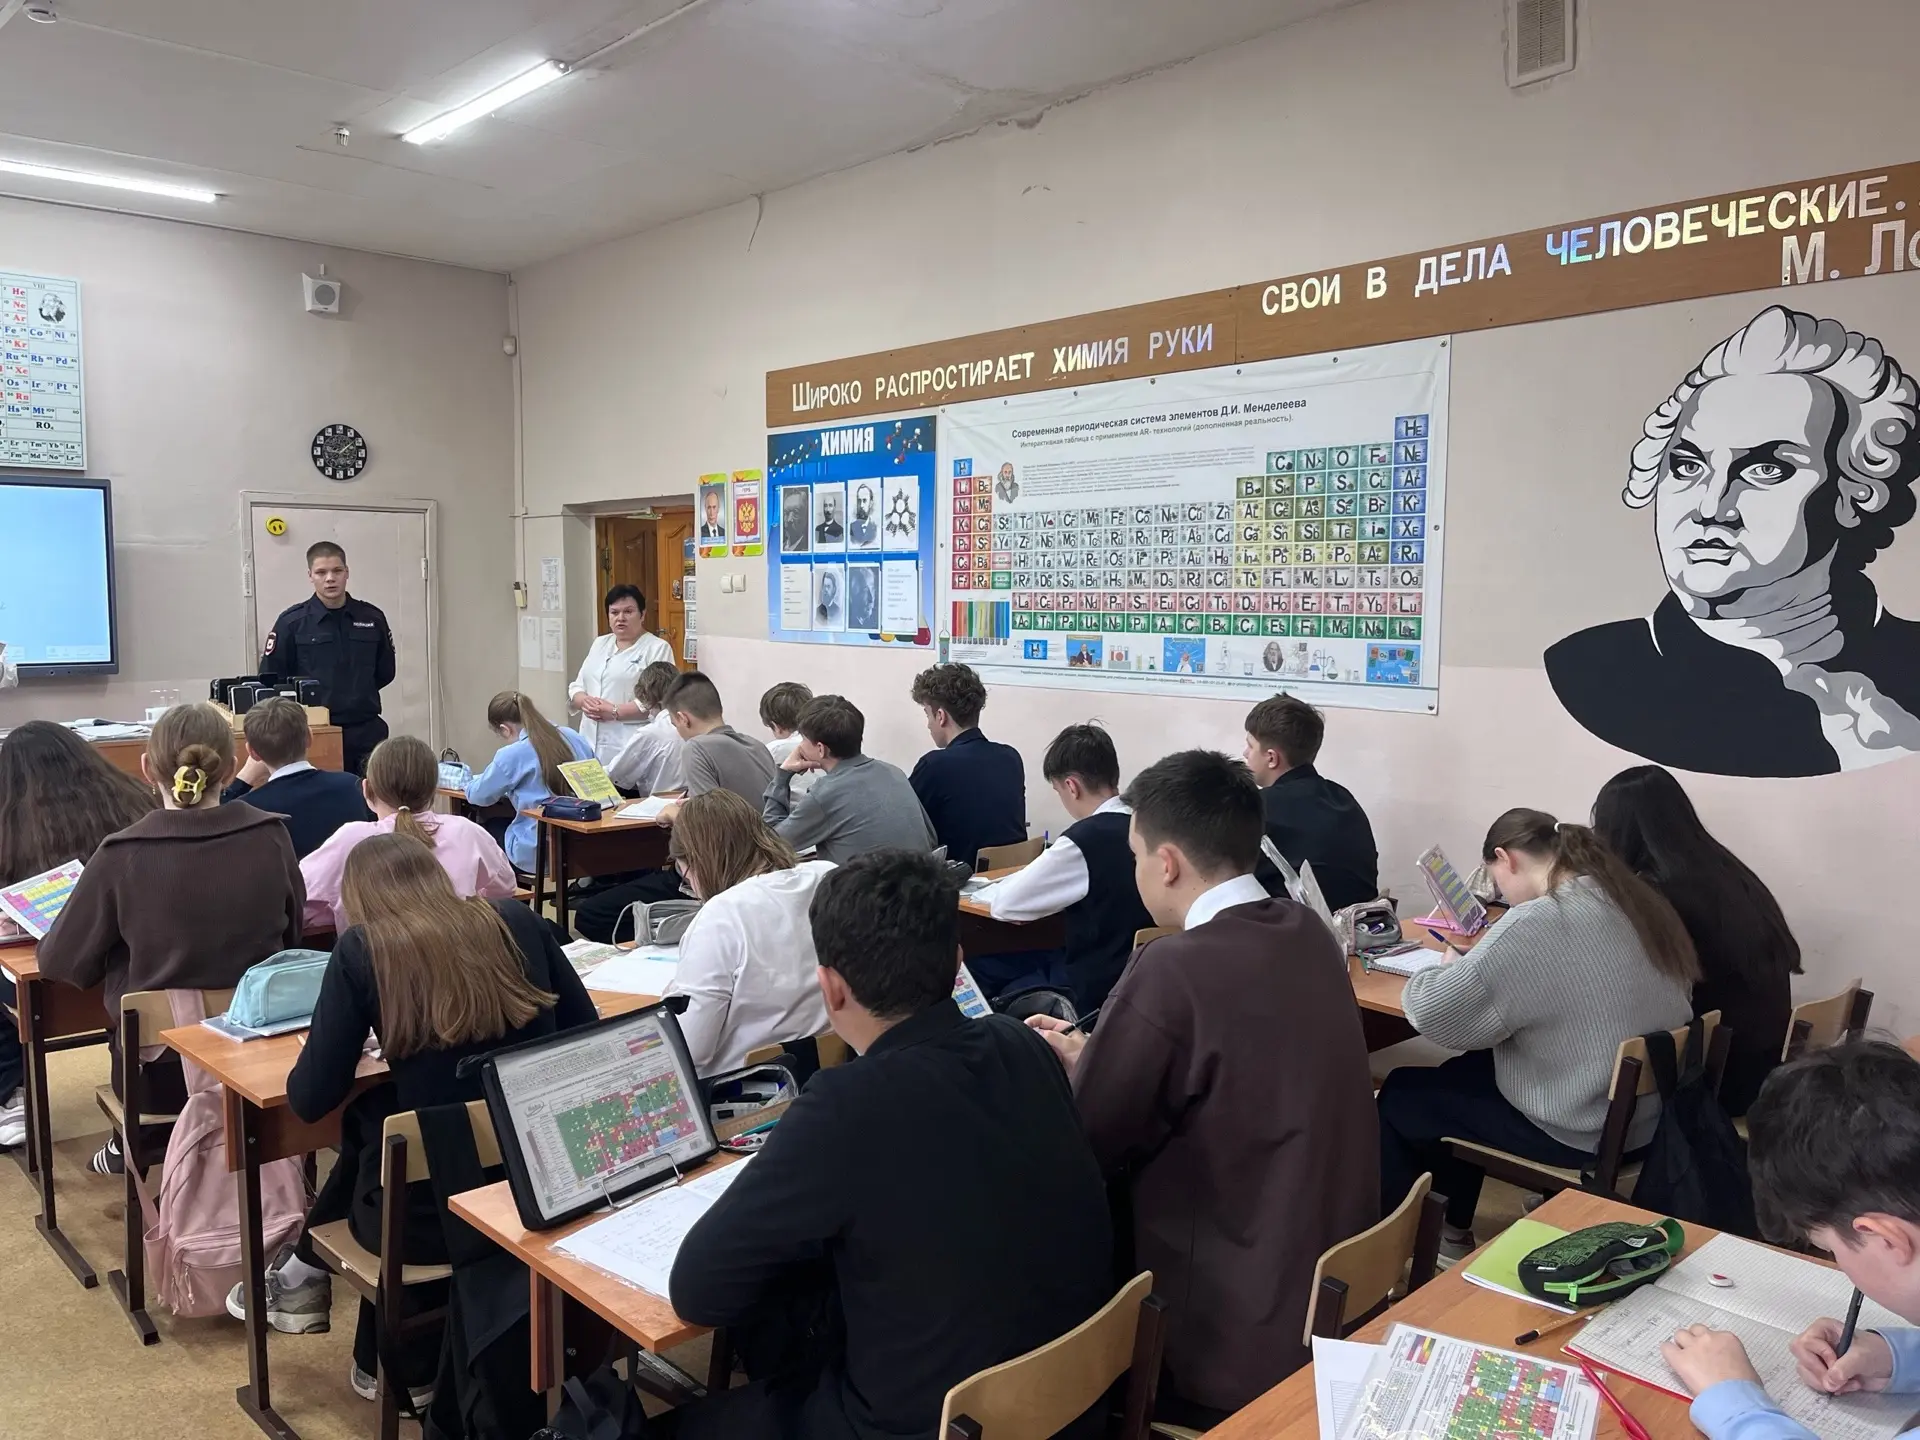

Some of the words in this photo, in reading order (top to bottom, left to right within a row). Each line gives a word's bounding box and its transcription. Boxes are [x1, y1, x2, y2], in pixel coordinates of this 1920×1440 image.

[1782, 228, 1840, 286] М.
[4, 326, 16, 334] Fe
[875, 351, 1035, 401] РАСПРОСТИРАЕТ
[1052, 337, 1129, 374] ХИМИЯ
[1148, 323, 1213, 360] РУКИ
[1262, 272, 1340, 317] СВОИ
[1366, 267, 1386, 299] В
[1415, 242, 1511, 297] ДЕЛА
[8, 405, 20, 413] Hs
[1012, 426, 1063, 439] Современная
[1066, 418, 1128, 433] периодическая
[1131, 415, 1166, 427] система
[1169, 408, 1219, 421] элементов
[1221, 404, 1241, 417] Д.И.
[1243, 398, 1306, 413] Менделеева
[821, 427, 874, 457] ХИМИЯ
[1275, 455, 1285, 470] C
[1305, 453, 1315, 468] N
[1337, 450, 1349, 466] O
[1370, 448, 1380, 464] F
[959, 500, 968, 512] Na
[978, 498, 989, 511] Mg
[1245, 481, 1253, 494] B
[1306, 476, 1315, 492] P
[1337, 474, 1346, 490] S
[1404, 470, 1419, 486] Ar
[978, 518, 989, 530] Ca
[1135, 509, 1150, 523] Co
[1216, 504, 1229, 519] Zn
[1305, 500, 1319, 515] As
[1369, 497, 1386, 512] Br
[1403, 495, 1418, 511] Kr
[1019, 535, 1028, 548] Zr
[1111, 531, 1122, 544] Ru
[1161, 529, 1173, 543] Pd
[1188, 528, 1201, 542] Ag
[1215, 527, 1229, 542] Cd
[1244, 526, 1259, 540] Ga
[1273, 525, 1287, 540] Sn
[1304, 524, 1319, 539] Sb
[978, 557, 987, 568] Ba
[1041, 554, 1051, 567] Ta
[1063, 554, 1072, 566] W
[1161, 551, 1172, 564] Pt
[1187, 550, 1200, 564] Au
[1214, 550, 1228, 564] Hg
[1273, 548, 1287, 563] Pb
[1335, 546, 1351, 562] Po
[1401, 545, 1417, 561] Rn
[977, 575, 986, 587] Ra
[1062, 574, 1073, 586] Sg
[1109, 573, 1121, 586] Hs
[1160, 572, 1172, 586] Ds
[1303, 571, 1317, 585] Mc
[1334, 570, 1348, 585] Lv
[1367, 570, 1380, 585] Ts
[1401, 570, 1418, 585] Og
[1018, 596, 1028, 608] La
[1062, 596, 1072, 608] Pr
[1110, 596, 1121, 608] Pm
[1134, 596, 1146, 608] Sm
[1160, 596, 1172, 609] Eu
[1185, 596, 1199, 609] Gd
[1214, 596, 1227, 610] Tb
[1242, 596, 1255, 610] Dy
[1271, 596, 1286, 610] Ho
[1302, 596, 1316, 610] Er
[1333, 596, 1348, 611] Tm
[1366, 597, 1382, 612] Yb
[1400, 596, 1416, 612] Lu
[1018, 615, 1028, 627] Ac
[1040, 615, 1050, 627] Th
[1062, 616, 1072, 628] Pa
[1085, 616, 1092, 628] U
[1133, 617, 1145, 630] Pu
[1240, 618, 1253, 632] Cf
[1333, 620, 1348, 635] Md
